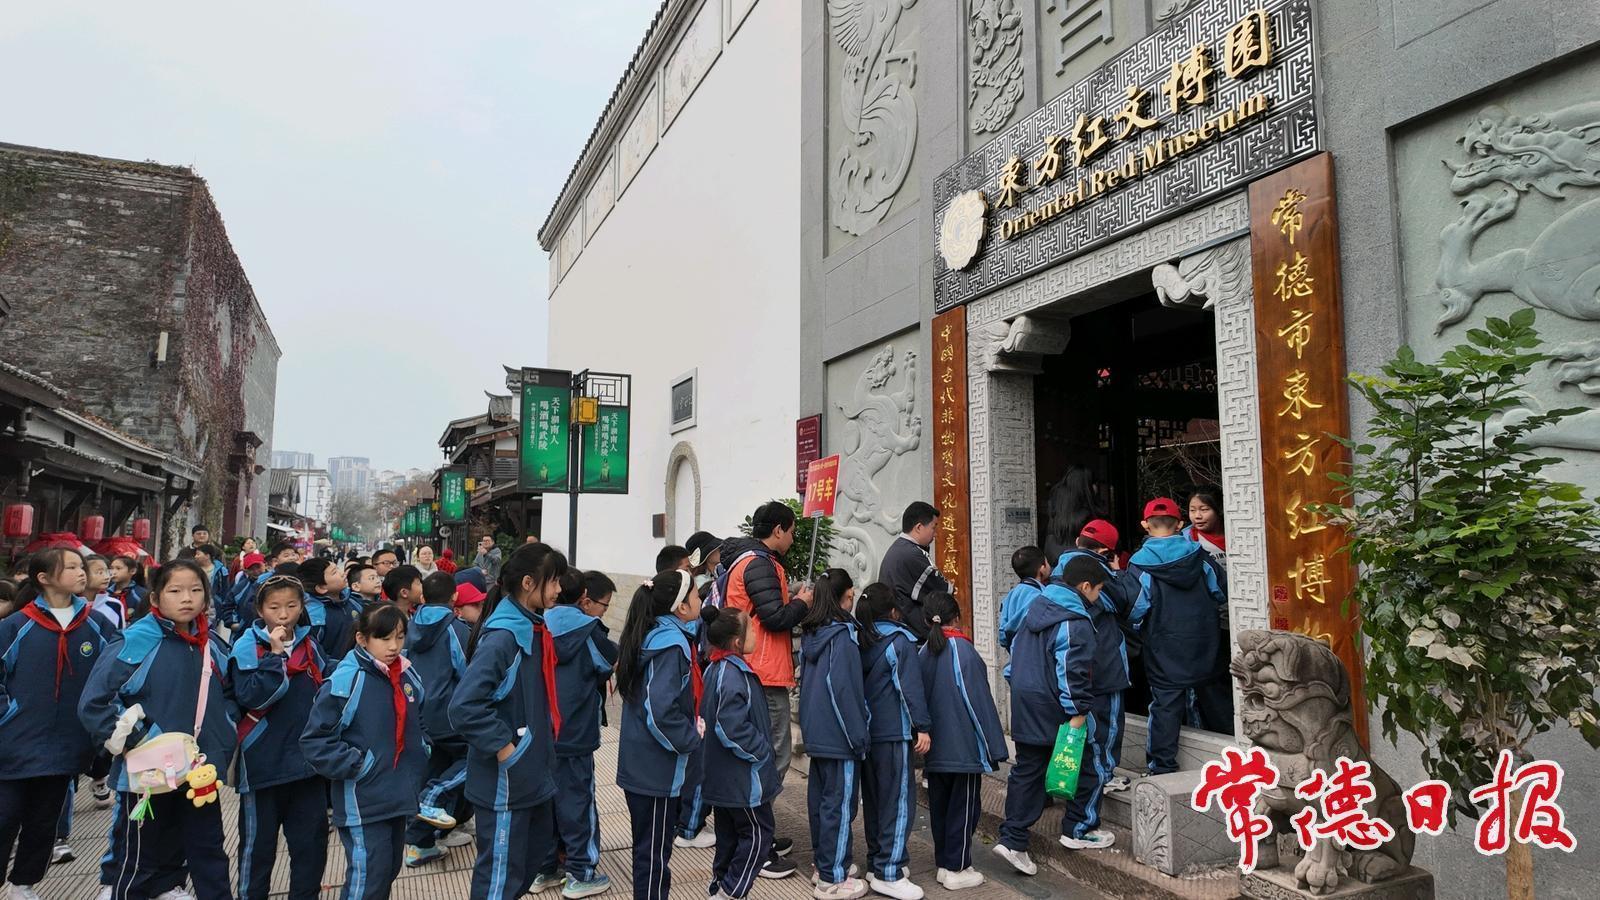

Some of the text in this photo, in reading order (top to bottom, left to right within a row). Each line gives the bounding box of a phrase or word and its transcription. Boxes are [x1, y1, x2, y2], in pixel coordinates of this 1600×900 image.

[1000, 93, 1268, 240] Oriental Red Museum
[808, 476, 834, 502] 17号车
